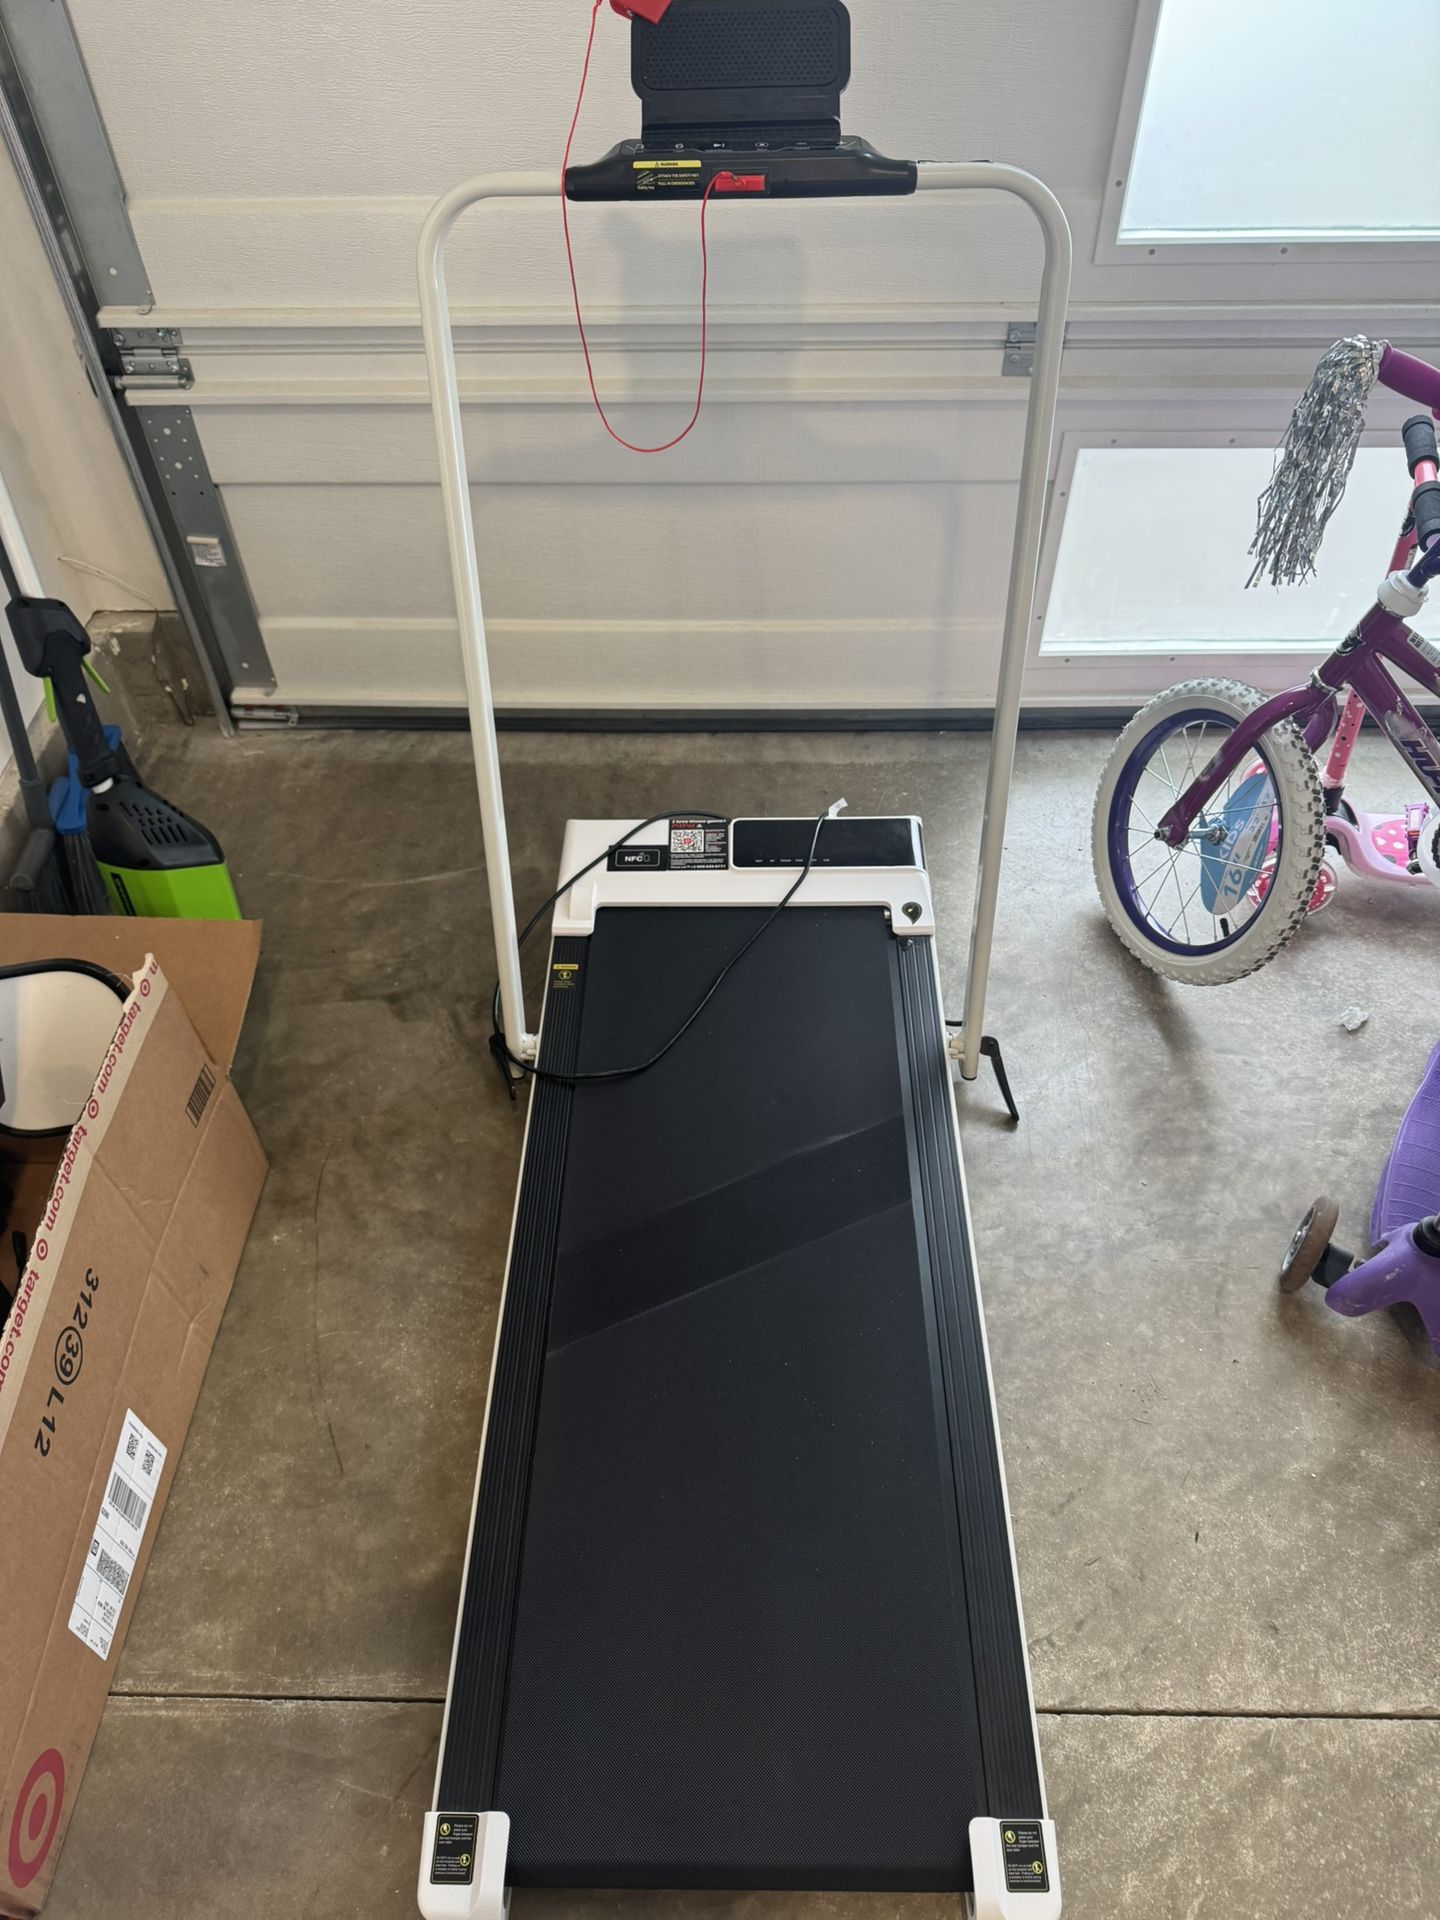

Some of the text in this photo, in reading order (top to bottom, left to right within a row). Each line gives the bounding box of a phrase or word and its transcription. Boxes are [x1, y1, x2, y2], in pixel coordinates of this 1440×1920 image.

[98, 1001, 141, 1094] target.com
[45, 1124, 88, 1231] target.com
[73, 1268, 99, 1329] 312
[59, 1333, 79, 1378] 39
